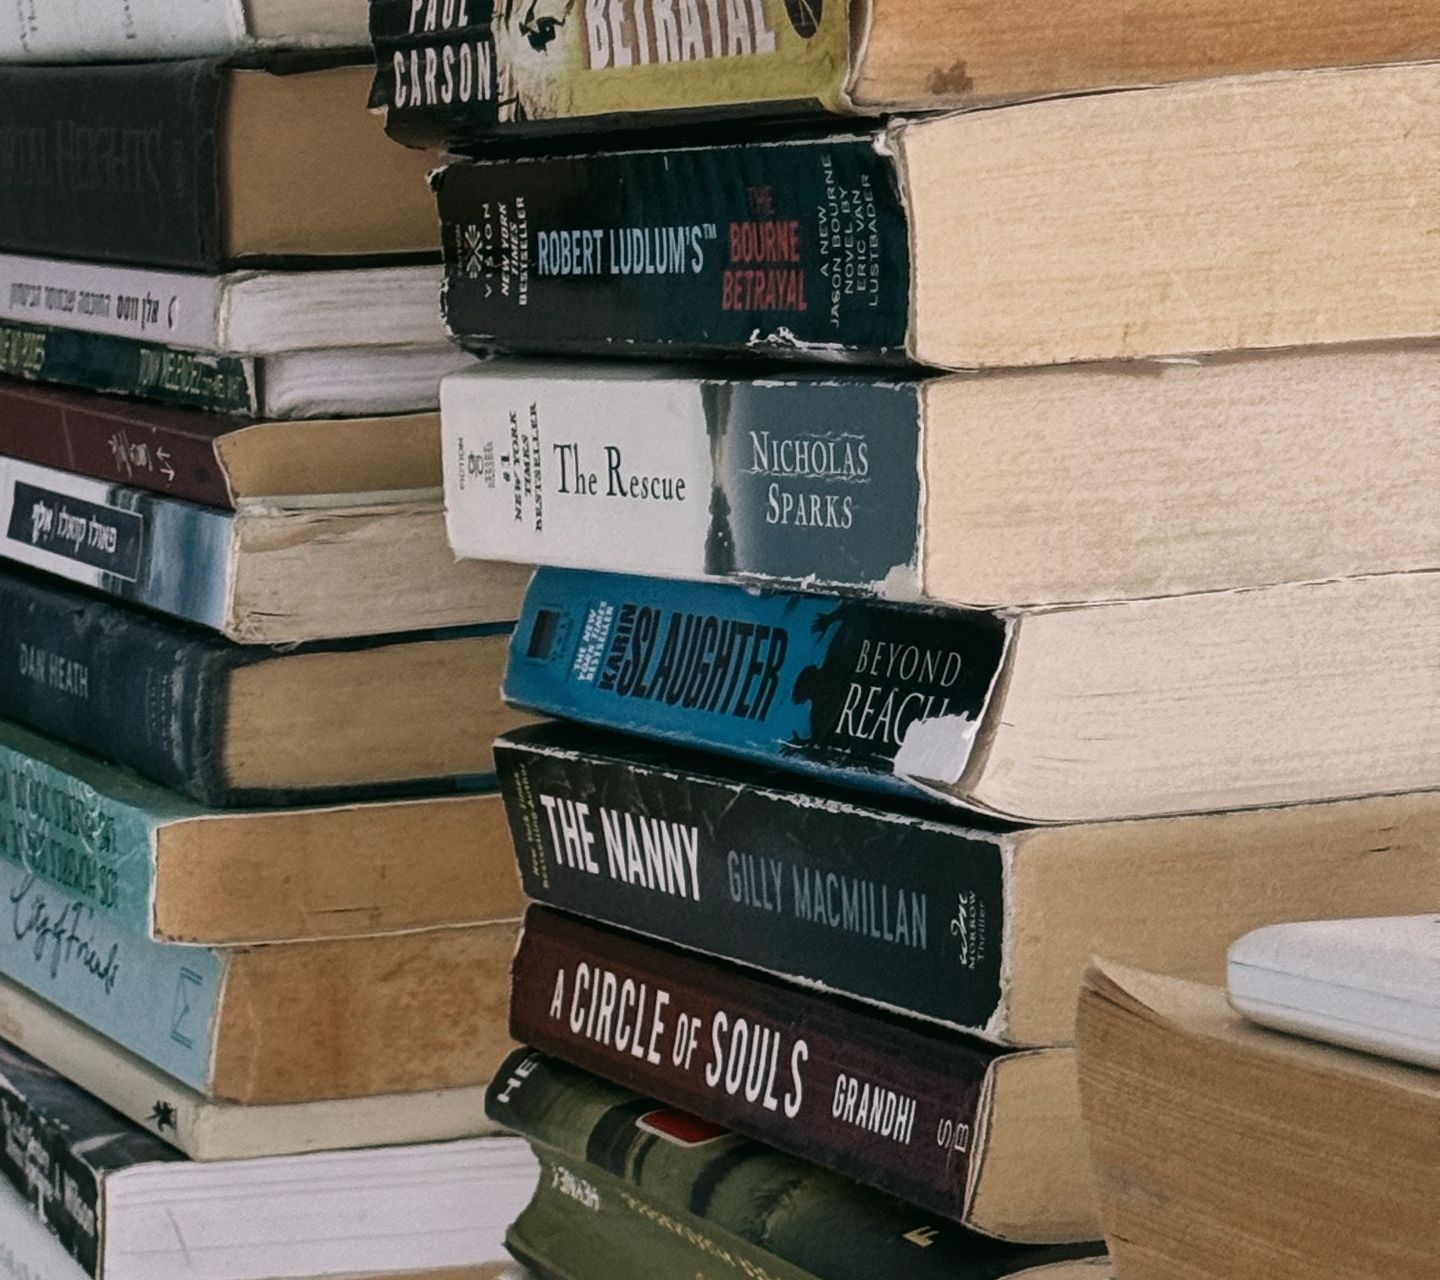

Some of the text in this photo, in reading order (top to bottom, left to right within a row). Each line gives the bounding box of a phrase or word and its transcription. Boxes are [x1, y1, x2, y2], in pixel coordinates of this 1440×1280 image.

[393, 40, 493, 109] CARSON
[498, 202, 510, 297] NEW YORK
[509, 222, 519, 276] TIMES
[515, 196, 528, 306] BESTSELLER
[537, 229, 604, 275] ROBERT
[730, 221, 800, 262] BOURNE
[817, 205, 829, 277] A NEW
[822, 154, 841, 328] JASON BOURNE
[838, 186, 853, 294] NOVEL BY
[852, 190, 866, 291] ERIC VAN
[861, 174, 879, 307] LUSTBADER
[722, 270, 808, 311] BETRAYAL
[509, 410, 523, 523] NEW YORK
[521, 434, 532, 497] TIMES
[529, 401, 543, 533] BESTSELLER
[553, 443, 597, 495] The
[604, 446, 687, 501] Rescue
[748, 430, 870, 478] NICHOLAS
[765, 483, 853, 530] SPARKS
[20, 643, 45, 683] DAN
[49, 652, 89, 699] HEATH
[598, 603, 637, 690] KARIN
[616, 605, 788, 722] SLAUGHTER
[854, 640, 961, 688] BEYOND
[539, 795, 929, 951] THE NANNY GILLY MACMILLAN
[969, 891, 977, 969] MORROW
[549, 968, 564, 1020] A
[569, 962, 669, 1066] CIRCLE
[672, 1013, 702, 1070] OF
[705, 1009, 809, 1120] SOULS
[832, 1073, 916, 1145] GRANDHI
